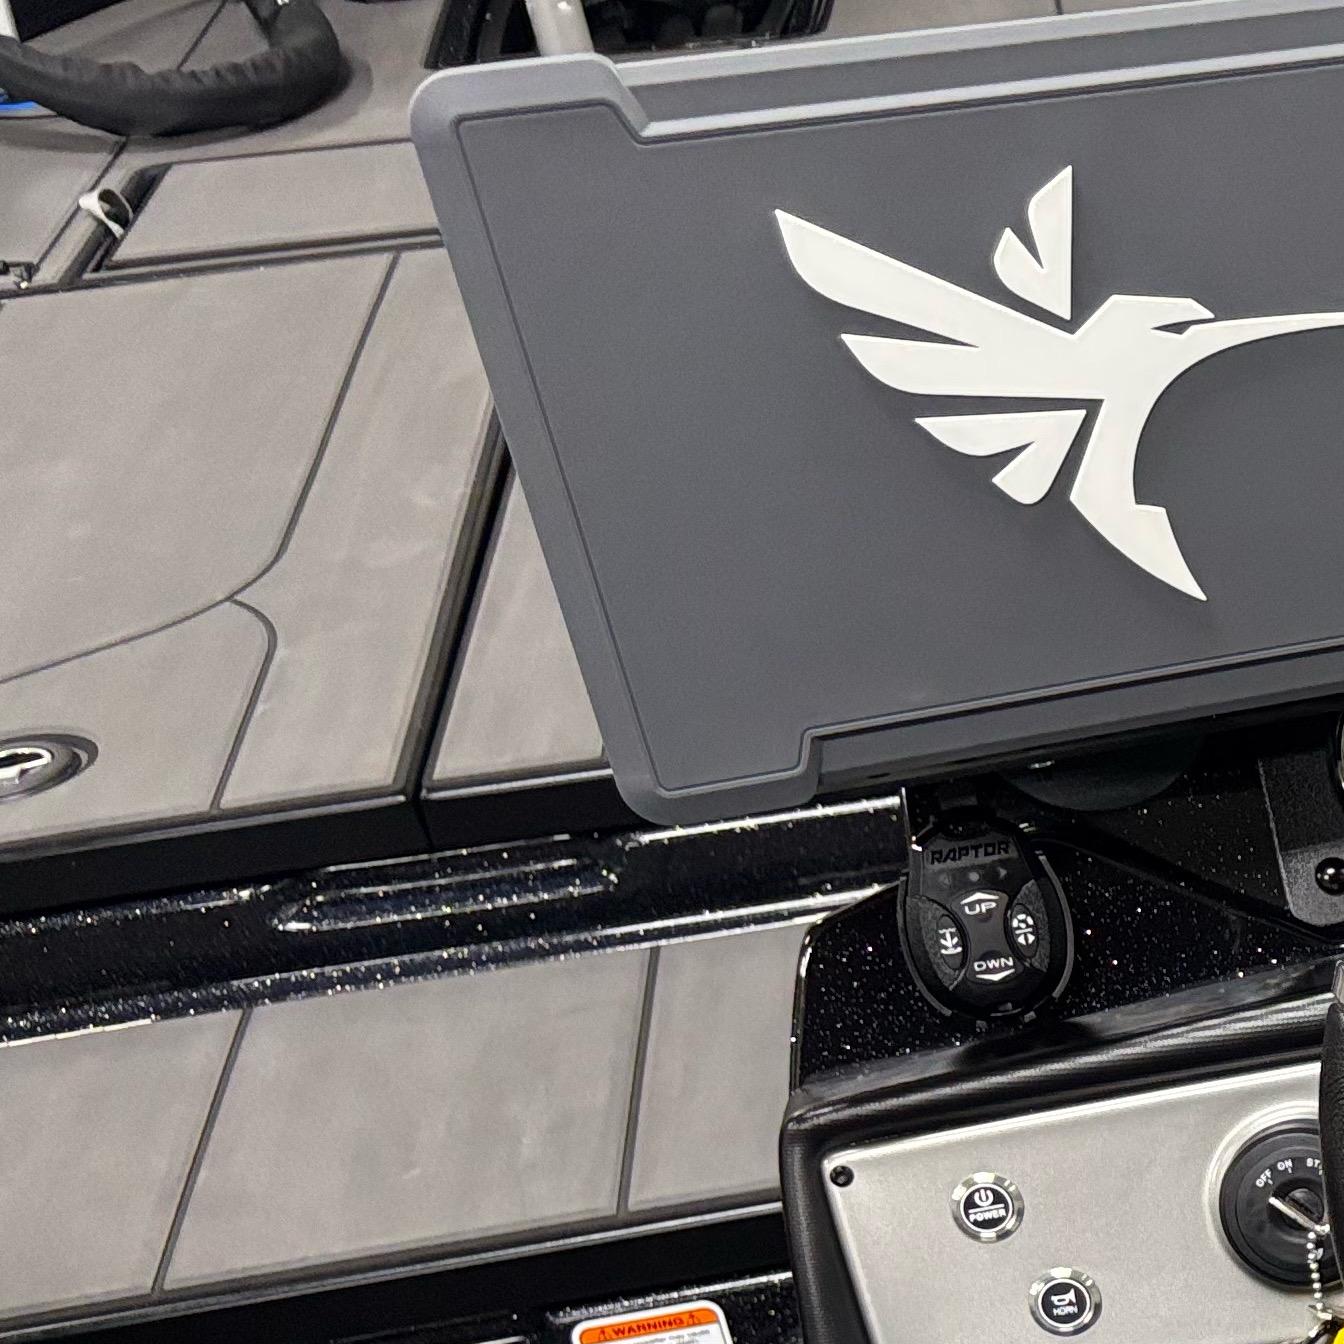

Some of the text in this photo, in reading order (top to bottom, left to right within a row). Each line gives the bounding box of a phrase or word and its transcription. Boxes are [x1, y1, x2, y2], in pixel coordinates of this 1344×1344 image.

[930, 841, 1009, 864] RAPTOR
[964, 901, 997, 915] UP
[973, 957, 1014, 971] DWN
[1277, 1159, 1293, 1171] ON
[1256, 1169, 1272, 1187] OFF
[969, 1208, 1006, 1222] POWER
[1053, 1305, 1078, 1316] HORN
[613, 1316, 685, 1336] WARNING
